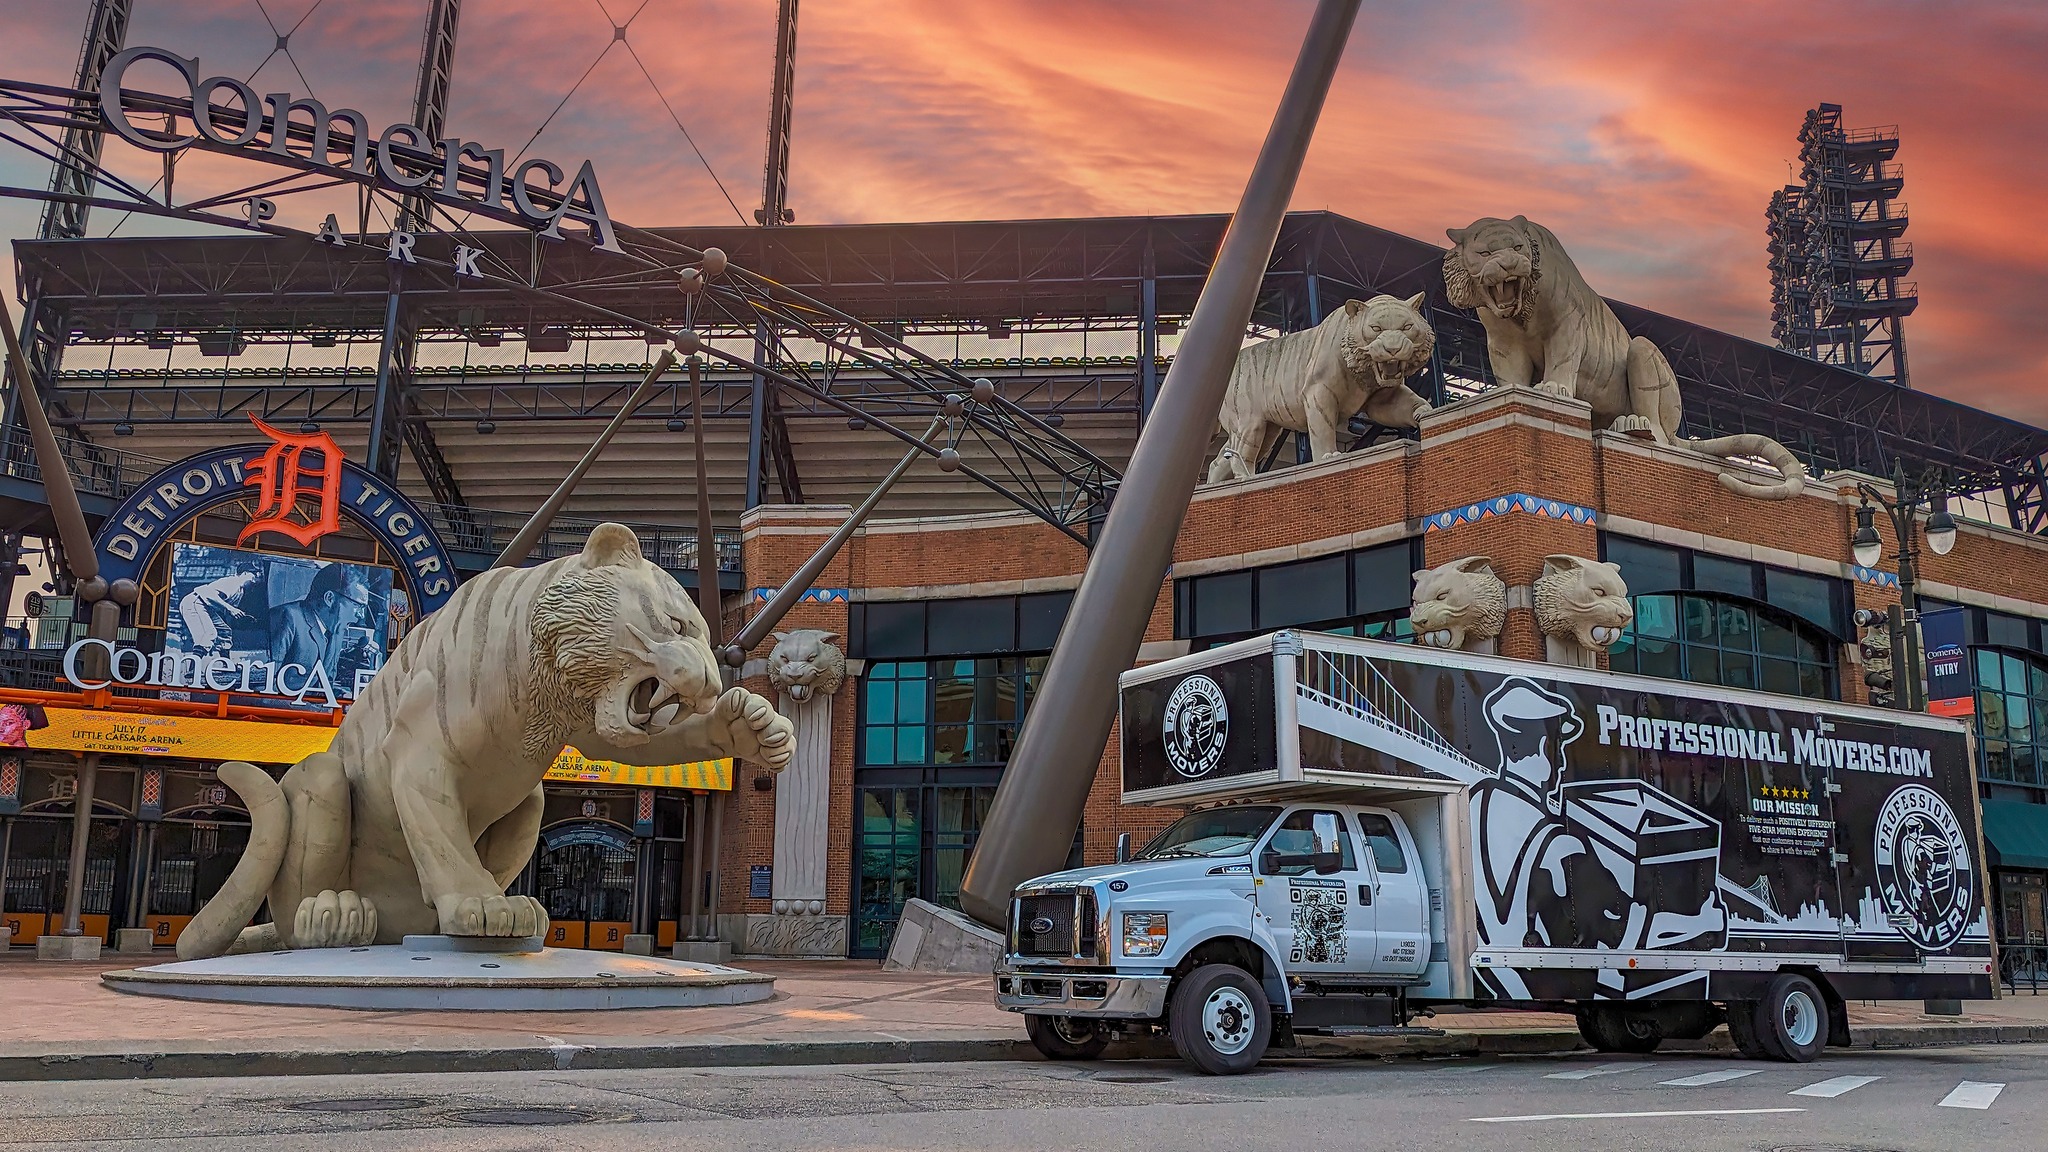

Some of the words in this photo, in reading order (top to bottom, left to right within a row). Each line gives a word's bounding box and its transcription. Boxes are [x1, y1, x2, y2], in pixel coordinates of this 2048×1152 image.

[246, 196, 484, 278] PARK
[106, 456, 245, 562] DETROIT
[354, 481, 451, 597] TIGERS
[1934, 661, 1959, 677] ENTRY
[1167, 679, 1223, 724] PROFESSIONAL
[72, 730, 103, 740] LITTLE
[105, 733, 147, 743] CAESARS
[150, 736, 183, 745] ARENA
[112, 724, 135, 734] JULY
[137, 726, 146, 735] 17
[1596, 704, 1788, 765] PROFESSIONAL
[1791, 727, 1934, 779] MOVERS.COM
[1167, 731, 1224, 773] MOVERS
[551, 762, 583, 771] CAESARS
[585, 765, 611, 773] ARENA
[1752, 798, 1774, 813] OUR
[1775, 799, 1819, 817] MISSION
[1748, 824, 1776, 834] FIVE-STAR
[1776, 826, 1797, 836] MOVING
[1797, 828, 1828, 838] EXPERIENCE
[1880, 793, 1963, 856] PROFESSIONAL
[1111, 882, 1126, 890] 157
